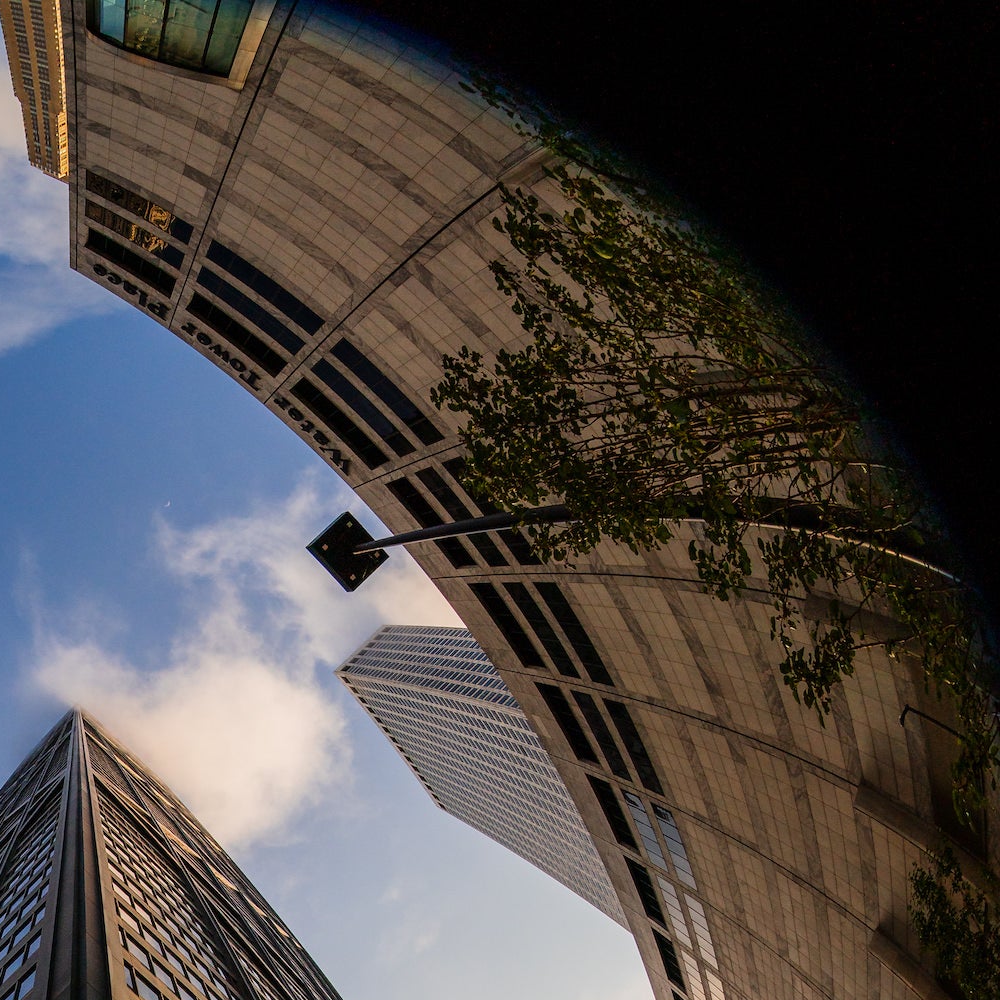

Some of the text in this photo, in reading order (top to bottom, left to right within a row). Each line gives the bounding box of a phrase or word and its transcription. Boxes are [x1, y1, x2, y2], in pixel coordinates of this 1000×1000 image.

[93, 263, 351, 476] Water Tower Place
